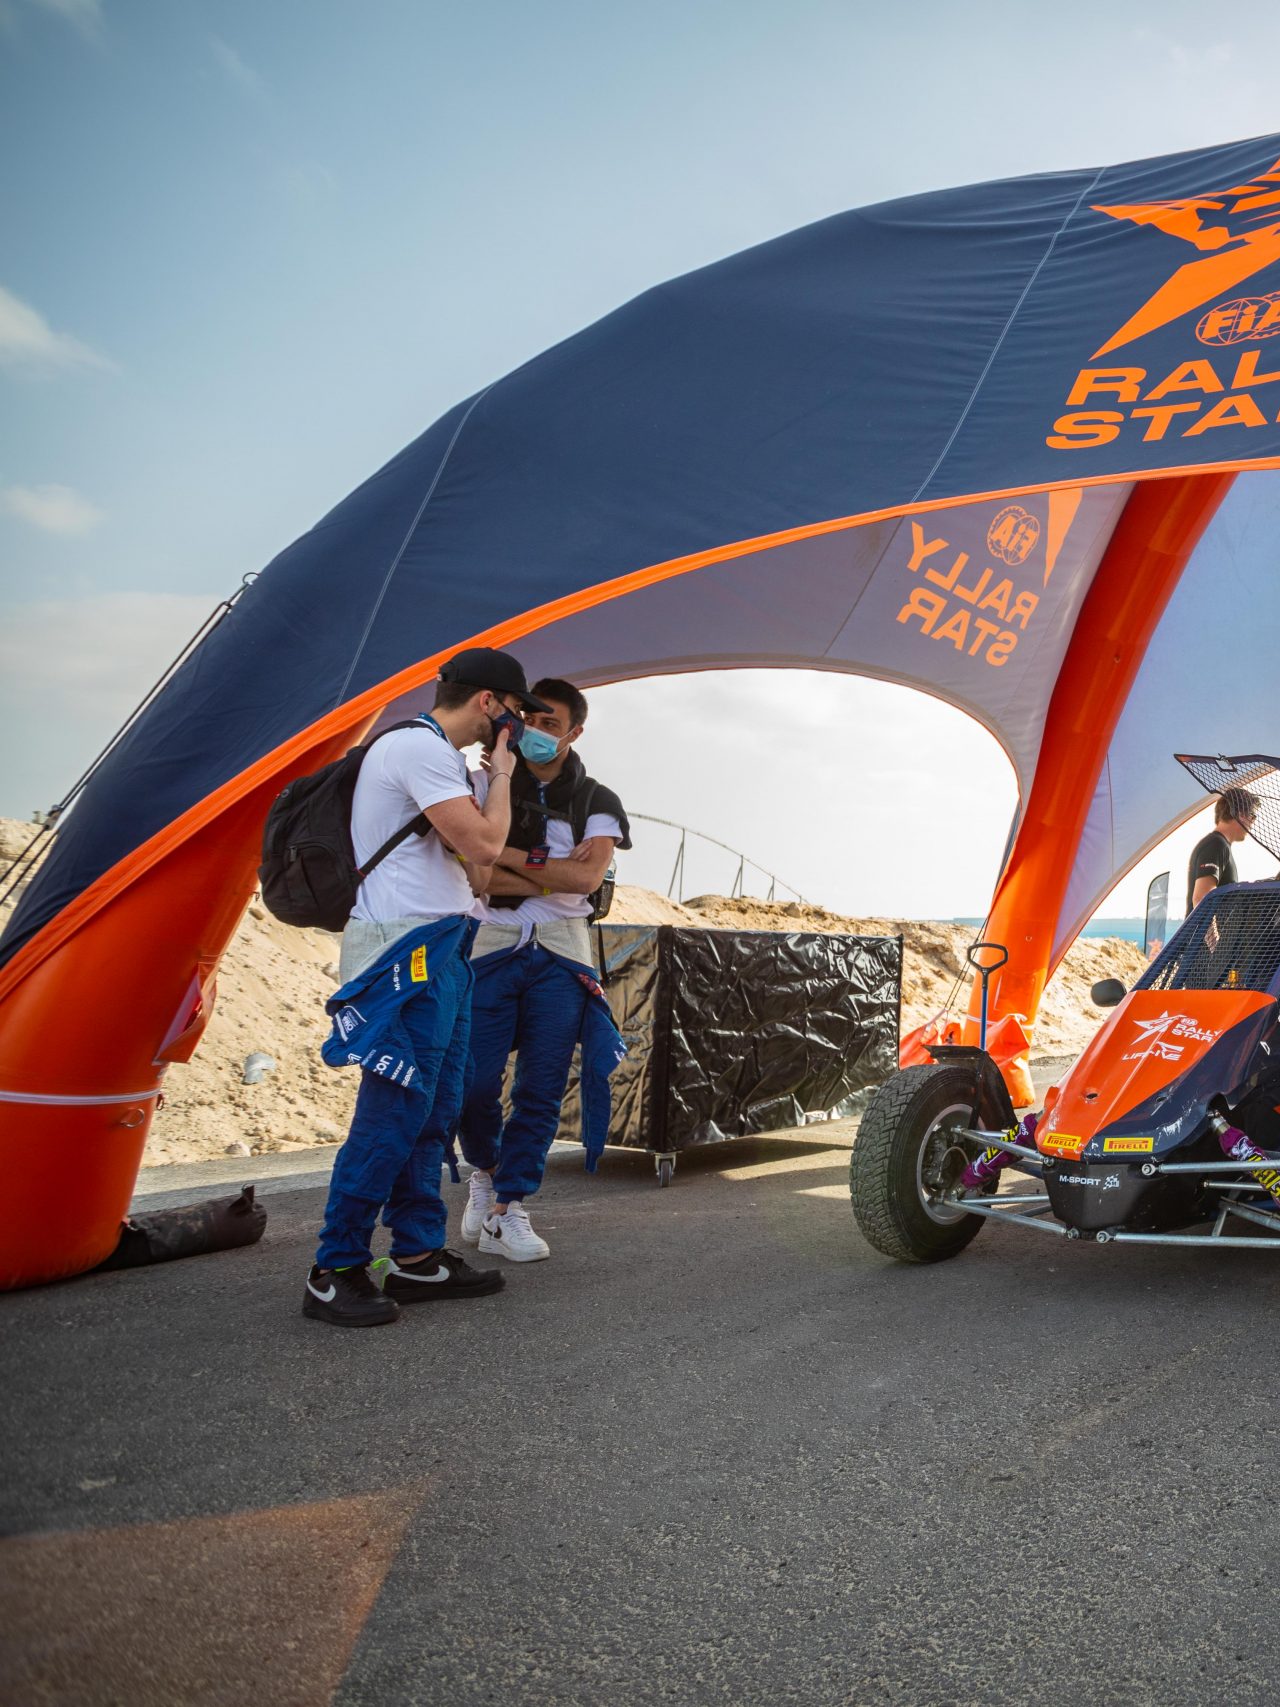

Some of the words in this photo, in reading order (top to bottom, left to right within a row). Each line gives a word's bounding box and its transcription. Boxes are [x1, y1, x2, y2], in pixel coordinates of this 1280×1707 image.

[1172, 1028, 1213, 1042] STAR
[1175, 1023, 1223, 1037] RALLY
[1046, 1135, 1077, 1147] PIRELLI
[1107, 1140, 1150, 1150] PIRELLI
[1059, 1175, 1101, 1187] M-SPORT
